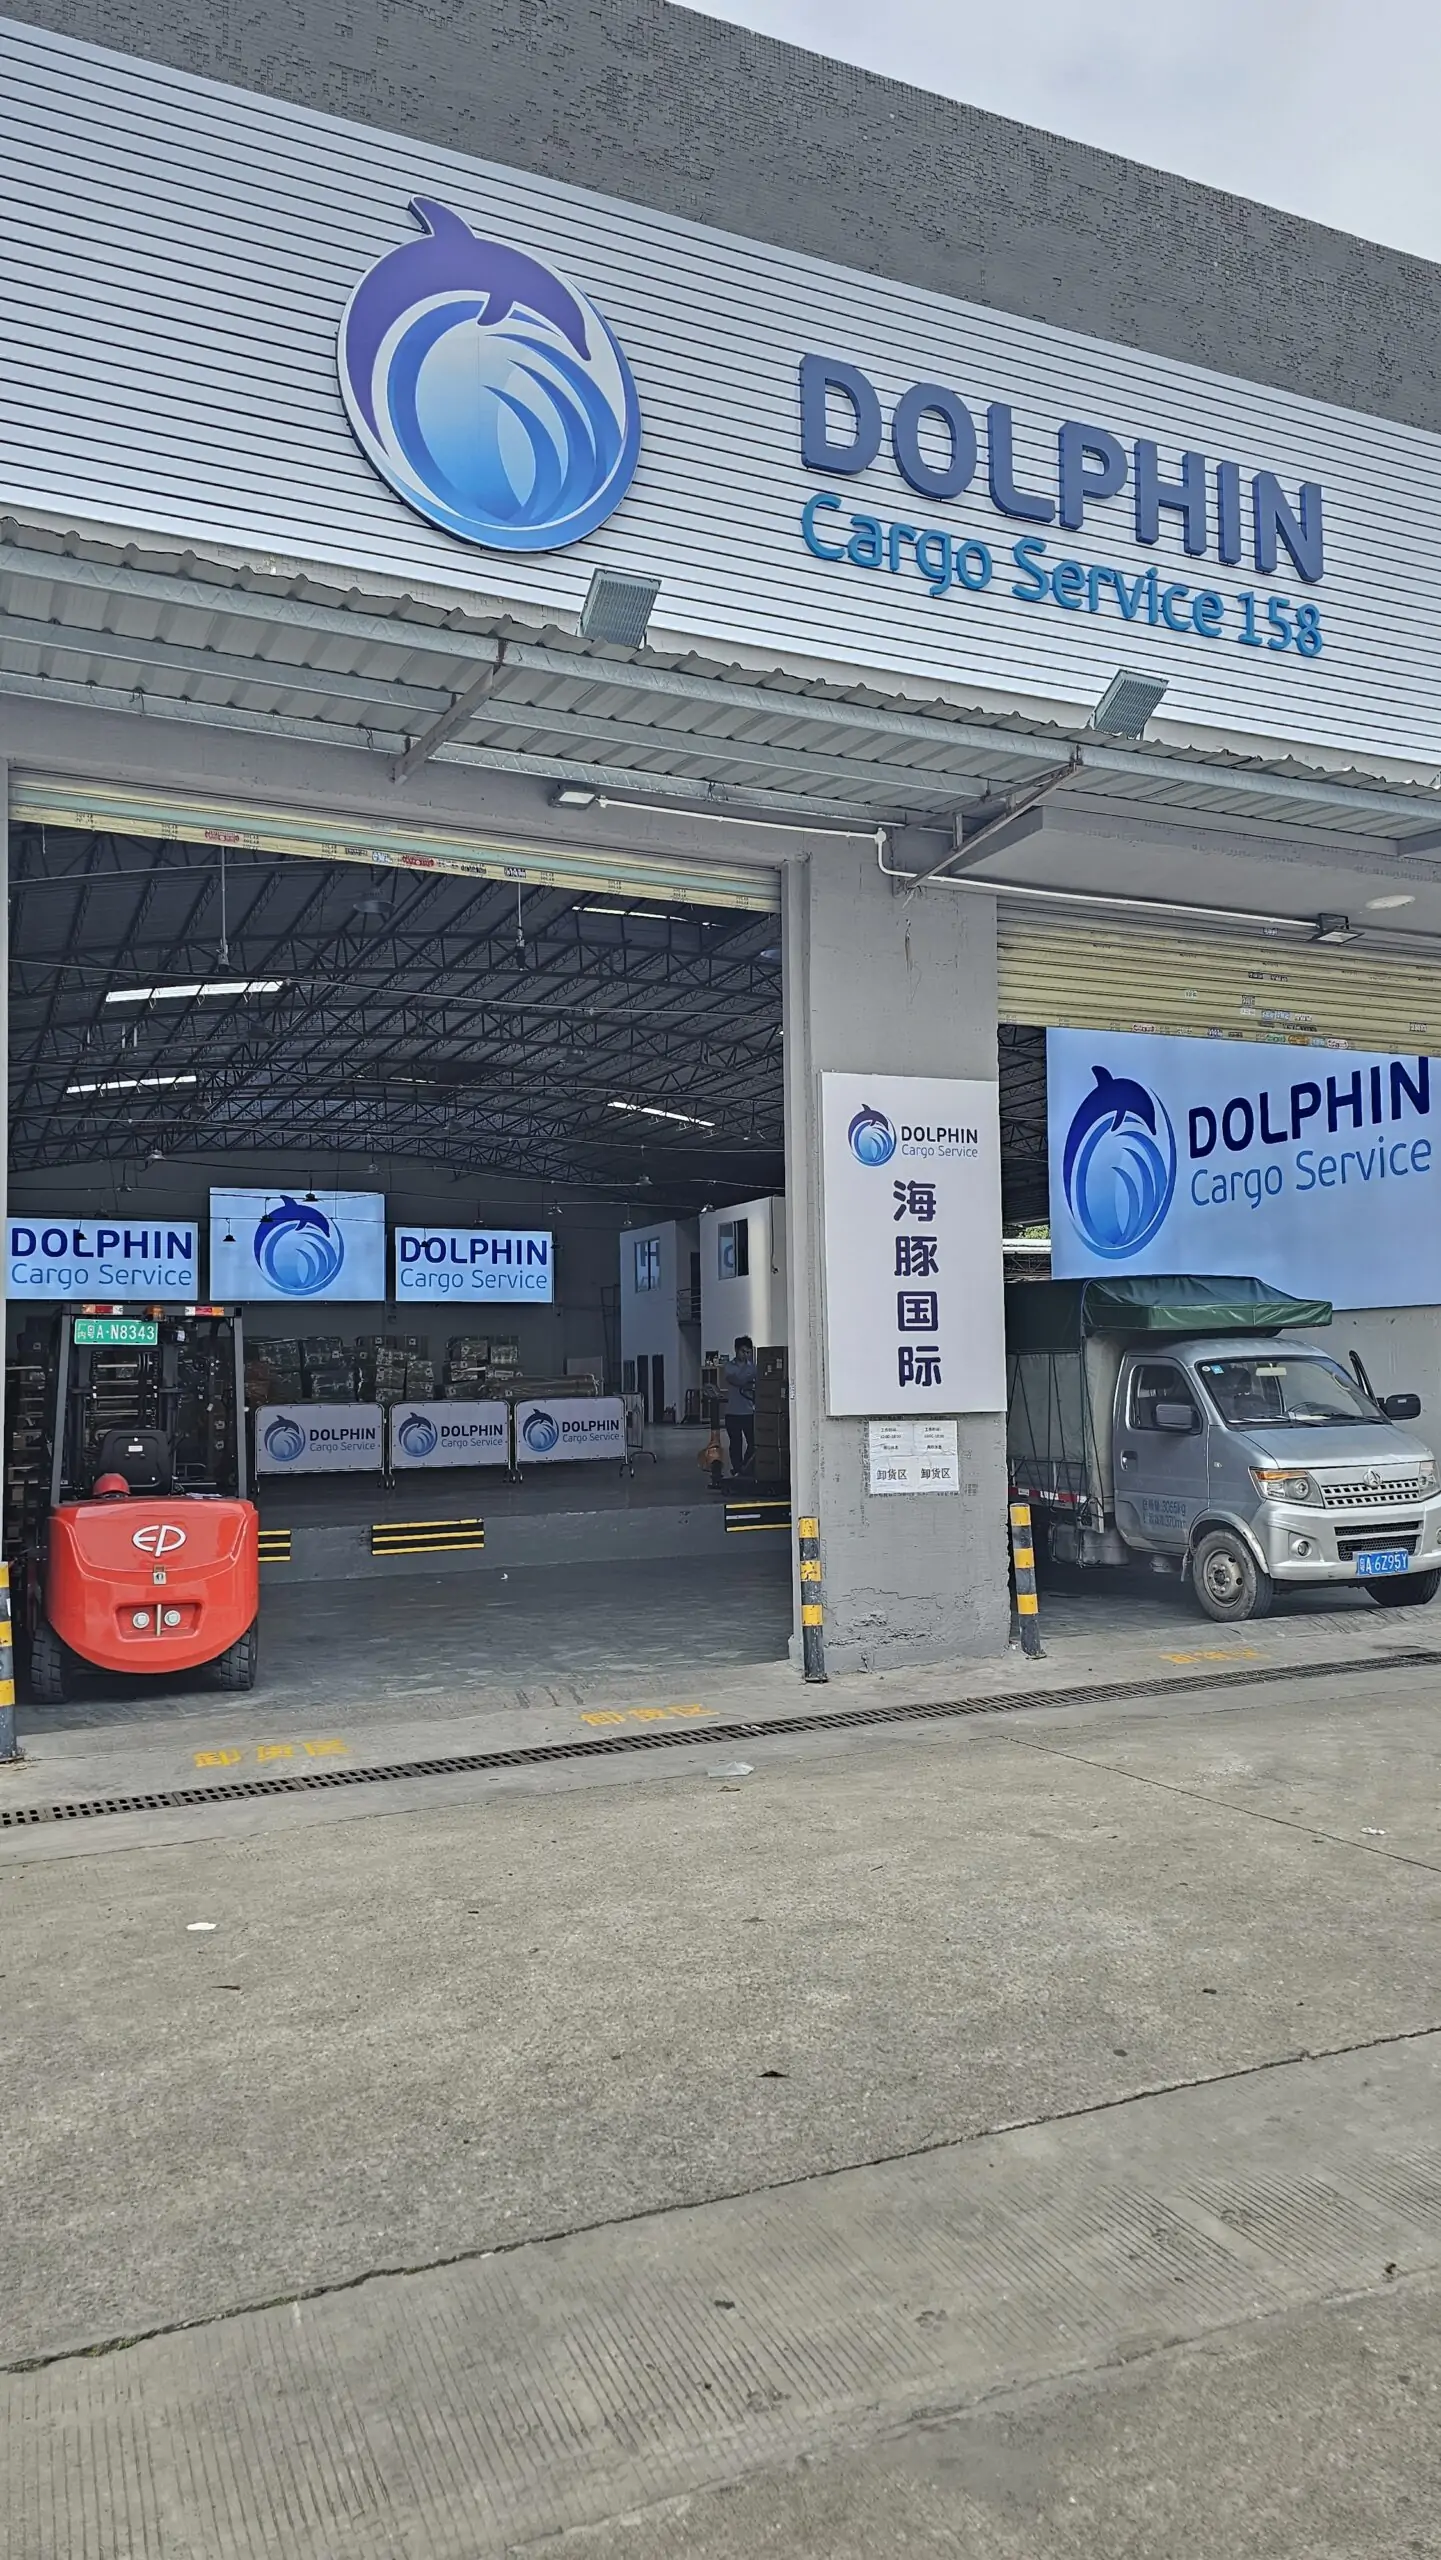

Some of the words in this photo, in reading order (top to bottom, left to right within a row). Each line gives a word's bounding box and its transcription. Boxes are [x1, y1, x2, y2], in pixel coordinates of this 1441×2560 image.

[800, 353, 1324, 583] DOLPHIN
[801, 493, 993, 597] Cargo
[1012, 537, 1224, 638] Service
[1237, 591, 1323, 658] 158
[1188, 1056, 1431, 1159] DOLPHIN
[901, 1126, 978, 1144] DOLPHIN
[901, 1144, 935, 1159] Cargo
[938, 1145, 978, 1158] Service
[1191, 1165, 1283, 1210] Cargo
[1295, 1136, 1432, 1191] Service
[11, 1227, 192, 1260] DOLPHIN
[400, 1236, 548, 1266] DOLPHIN
[11, 1263, 89, 1290] Cargo
[98, 1264, 192, 1286] Service
[400, 1268, 464, 1293] Cargo
[471, 1269, 548, 1289] Service
[893, 1180, 942, 1388] 海豚国际
[309, 1427, 376, 1441] DOLPHIN
[440, 1424, 503, 1438] DOLPHIN
[561, 1419, 620, 1433] DOLPHIN
[309, 1442, 339, 1454] Cargo
[341, 1441, 376, 1451] Service
[440, 1438, 468, 1449] Cargo
[470, 1436, 503, 1447] Service
[562, 1433, 588, 1444] Cargo
[589, 1431, 620, 1442] Service
[876, 1468, 908, 1481] 卸货区
[920, 1467, 951, 1480] 卸货区
[132, 1523, 186, 1557] EP
